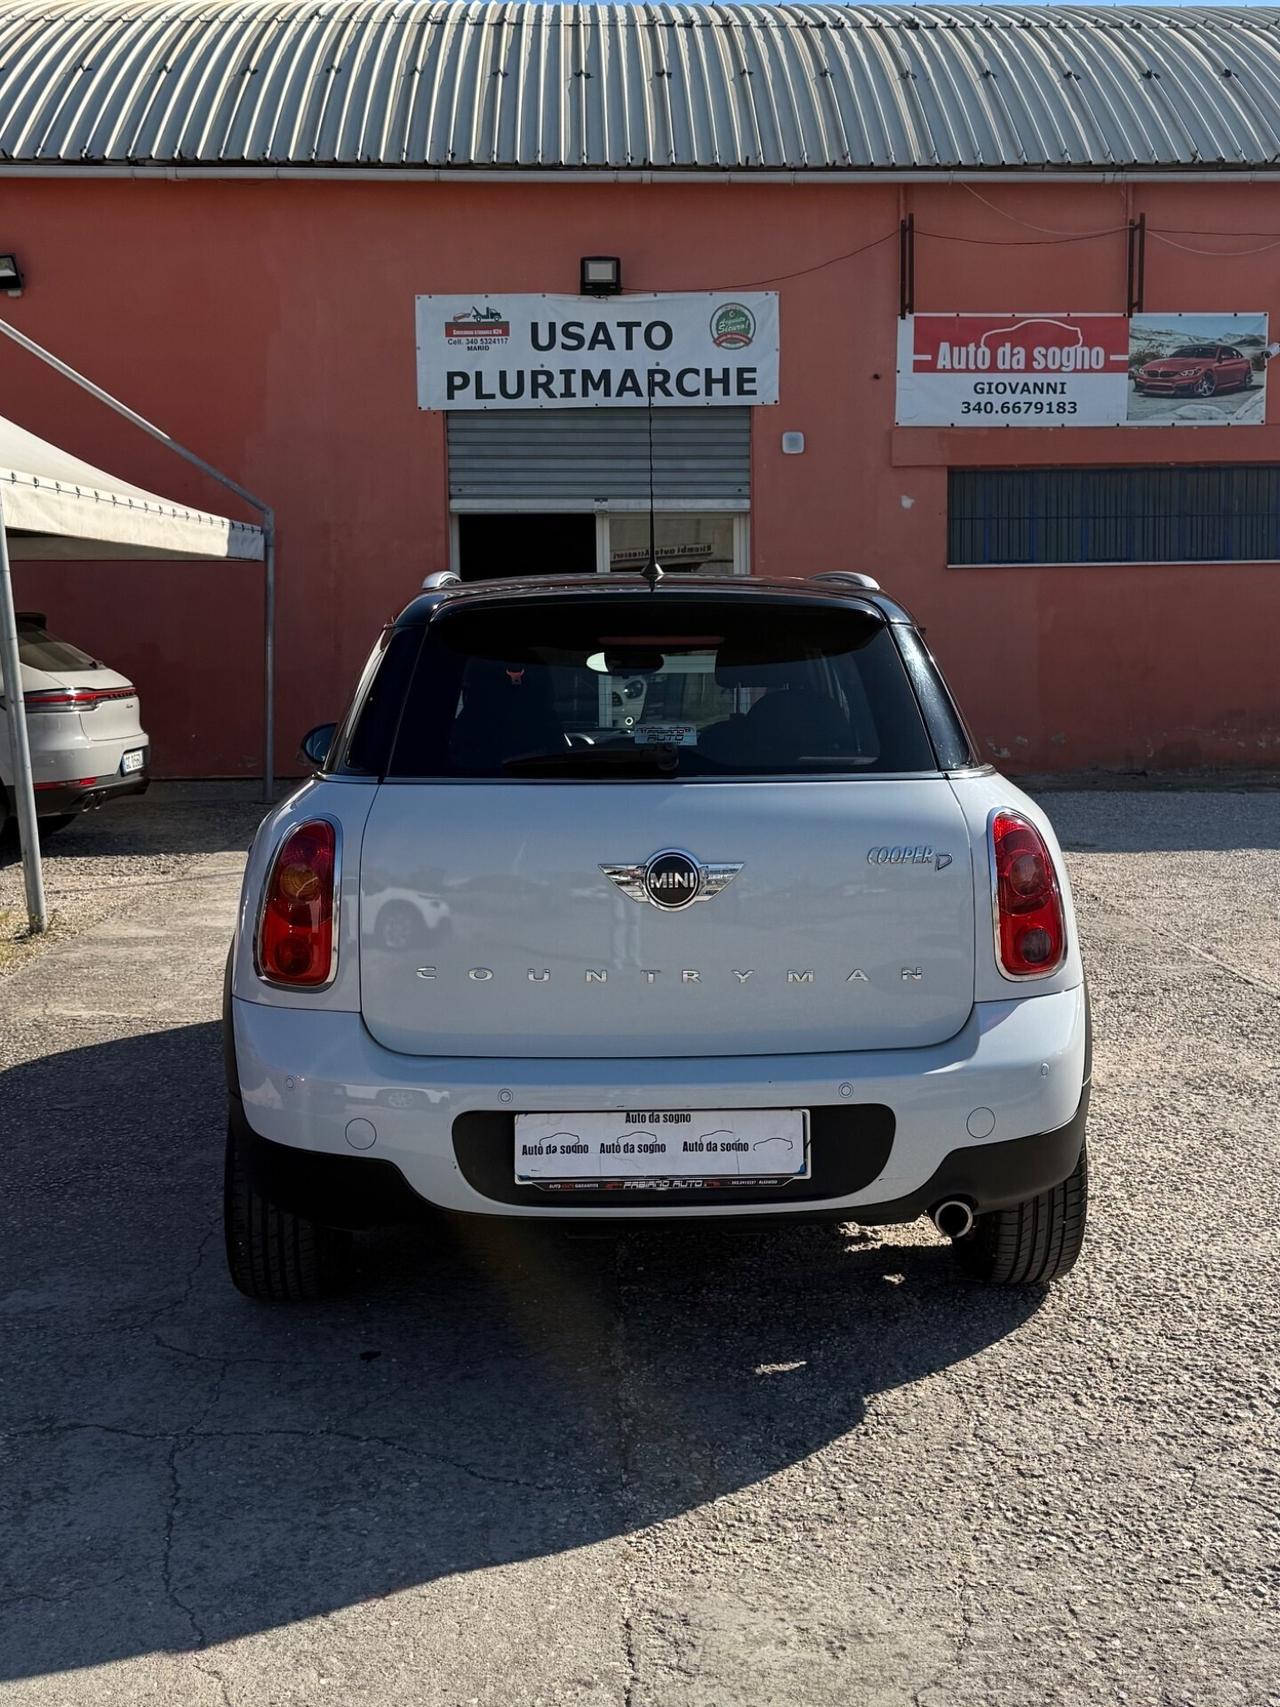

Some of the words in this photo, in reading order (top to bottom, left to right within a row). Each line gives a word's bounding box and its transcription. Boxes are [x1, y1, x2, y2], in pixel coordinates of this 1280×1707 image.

[530, 320, 673, 352] USATO
[937, 342, 991, 370] Auto
[997, 342, 1025, 370] da
[1032, 346, 1105, 373] sogno
[446, 366, 758, 400] PLURIMARCHE
[973, 382, 1067, 396] GIOVANNI
[960, 400, 1078, 415] 340.6679183
[867, 846, 934, 865] COOPER
[934, 853, 953, 872] D
[649, 871, 696, 889] MINI
[416, 966, 923, 985] COUNTRYMAN
[625, 1112, 646, 1124] Auto
[648, 1112, 660, 1124] da
[662, 1113, 692, 1124] sogno
[522, 1144, 543, 1156] Auto
[545, 1143, 558, 1155] da
[600, 1142, 621, 1154] Auto
[623, 1142, 635, 1154] da
[637, 1143, 667, 1154] sogno
[682, 1141, 704, 1153] Auto
[706, 1141, 718, 1152] da
[672, 1180, 702, 1189] AUTO
